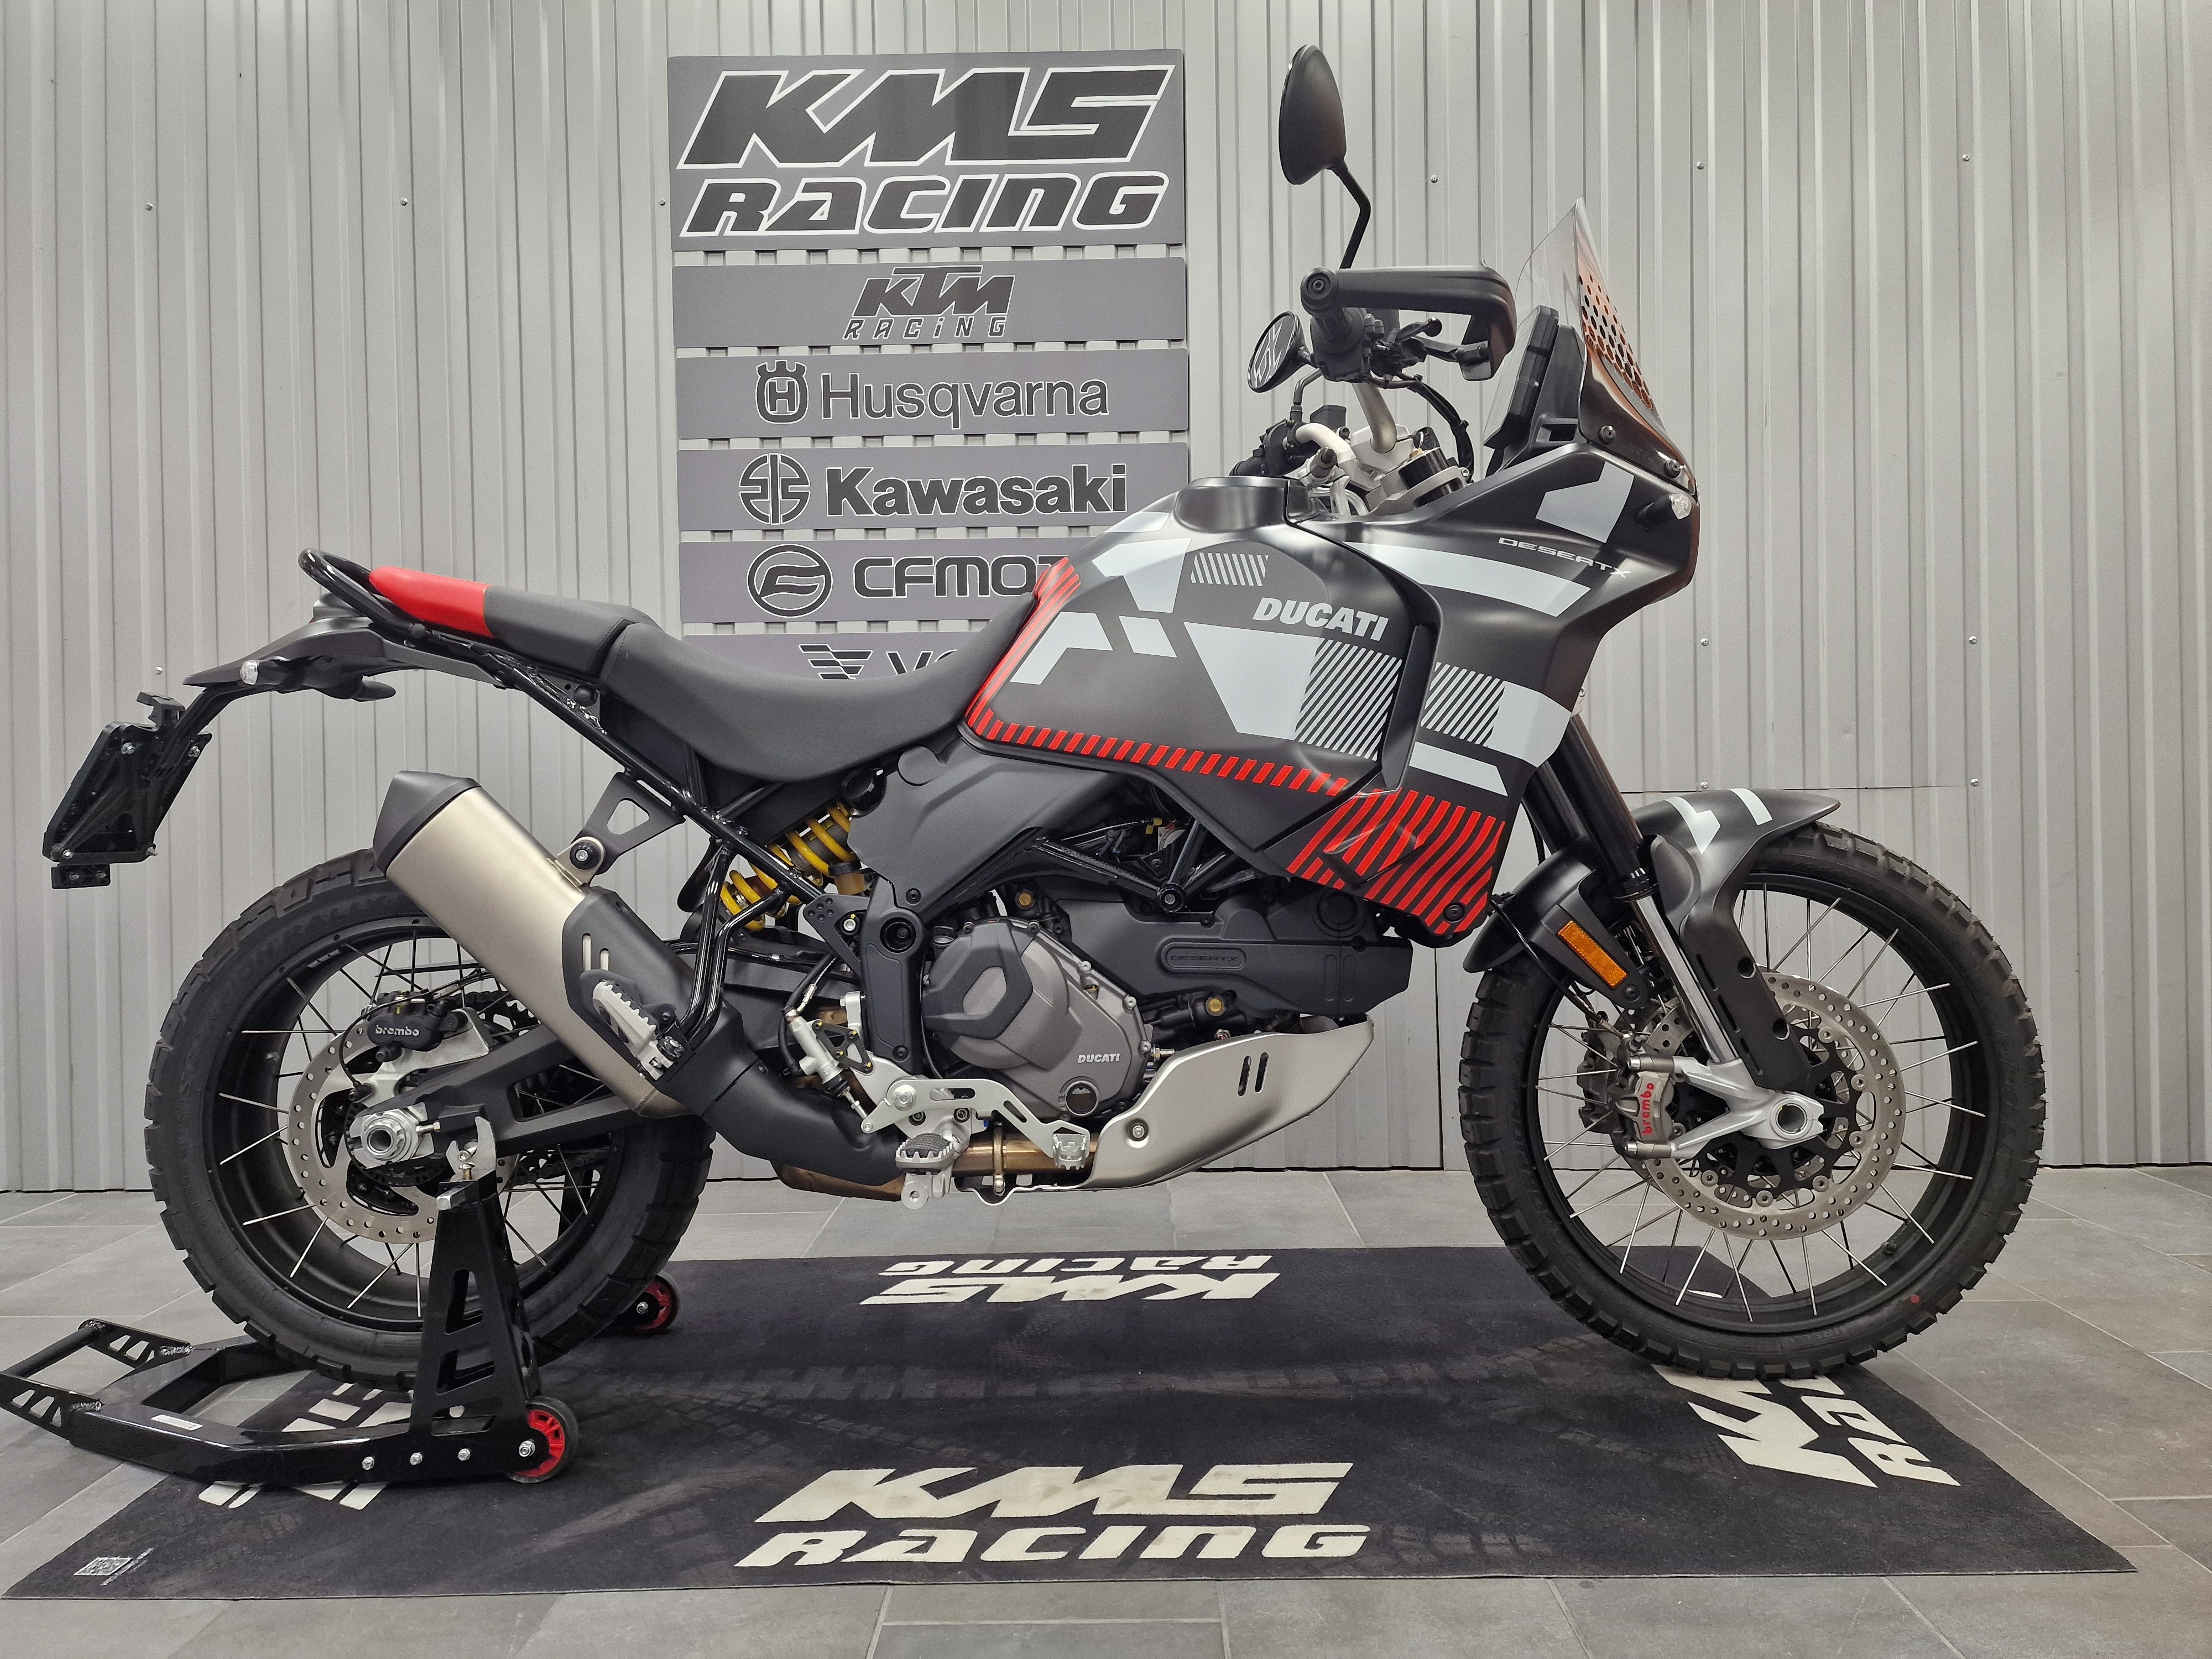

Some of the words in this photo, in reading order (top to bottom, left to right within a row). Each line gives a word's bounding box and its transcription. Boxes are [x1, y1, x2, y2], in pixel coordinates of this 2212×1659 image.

[676, 65, 1176, 169] KMS
[679, 170, 1170, 237] RACING
[851, 265, 1016, 317] KTM
[821, 372, 1110, 430] Husqvarna
[825, 463, 1128, 517] Kawasaki
[1252, 597, 1389, 641] DUCATI
[375, 1024, 420, 1036] brembo
[1078, 1053, 1120, 1063] DUCATI
[1640, 1082, 1655, 1135] brembo
[859, 1273, 1281, 1305] KMS
[878, 1256, 1273, 1276] RACING
[754, 1462, 1354, 1522] KMS
[734, 1524, 1371, 1567] RACING
